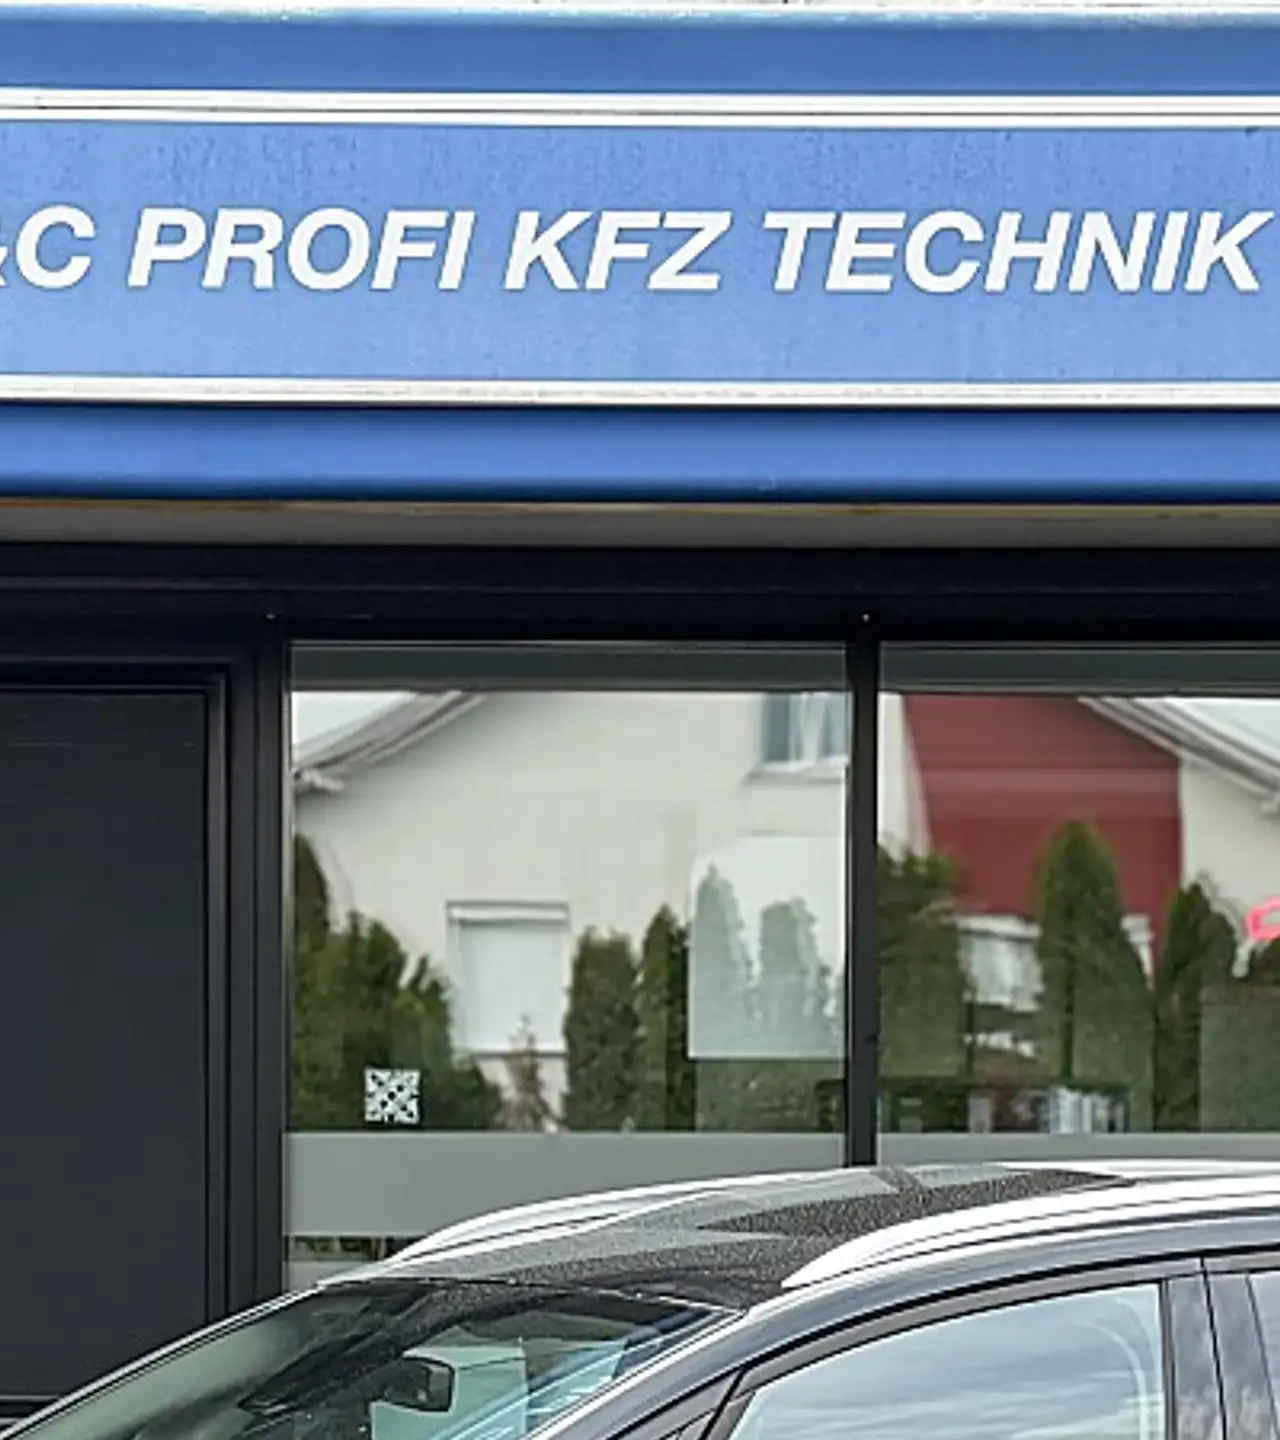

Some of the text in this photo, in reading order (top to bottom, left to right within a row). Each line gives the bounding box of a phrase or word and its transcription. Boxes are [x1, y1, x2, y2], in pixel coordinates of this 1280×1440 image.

[127, 208, 476, 290] PROFI
[504, 211, 731, 290] KFZ
[763, 211, 1276, 292] TECHNIK
